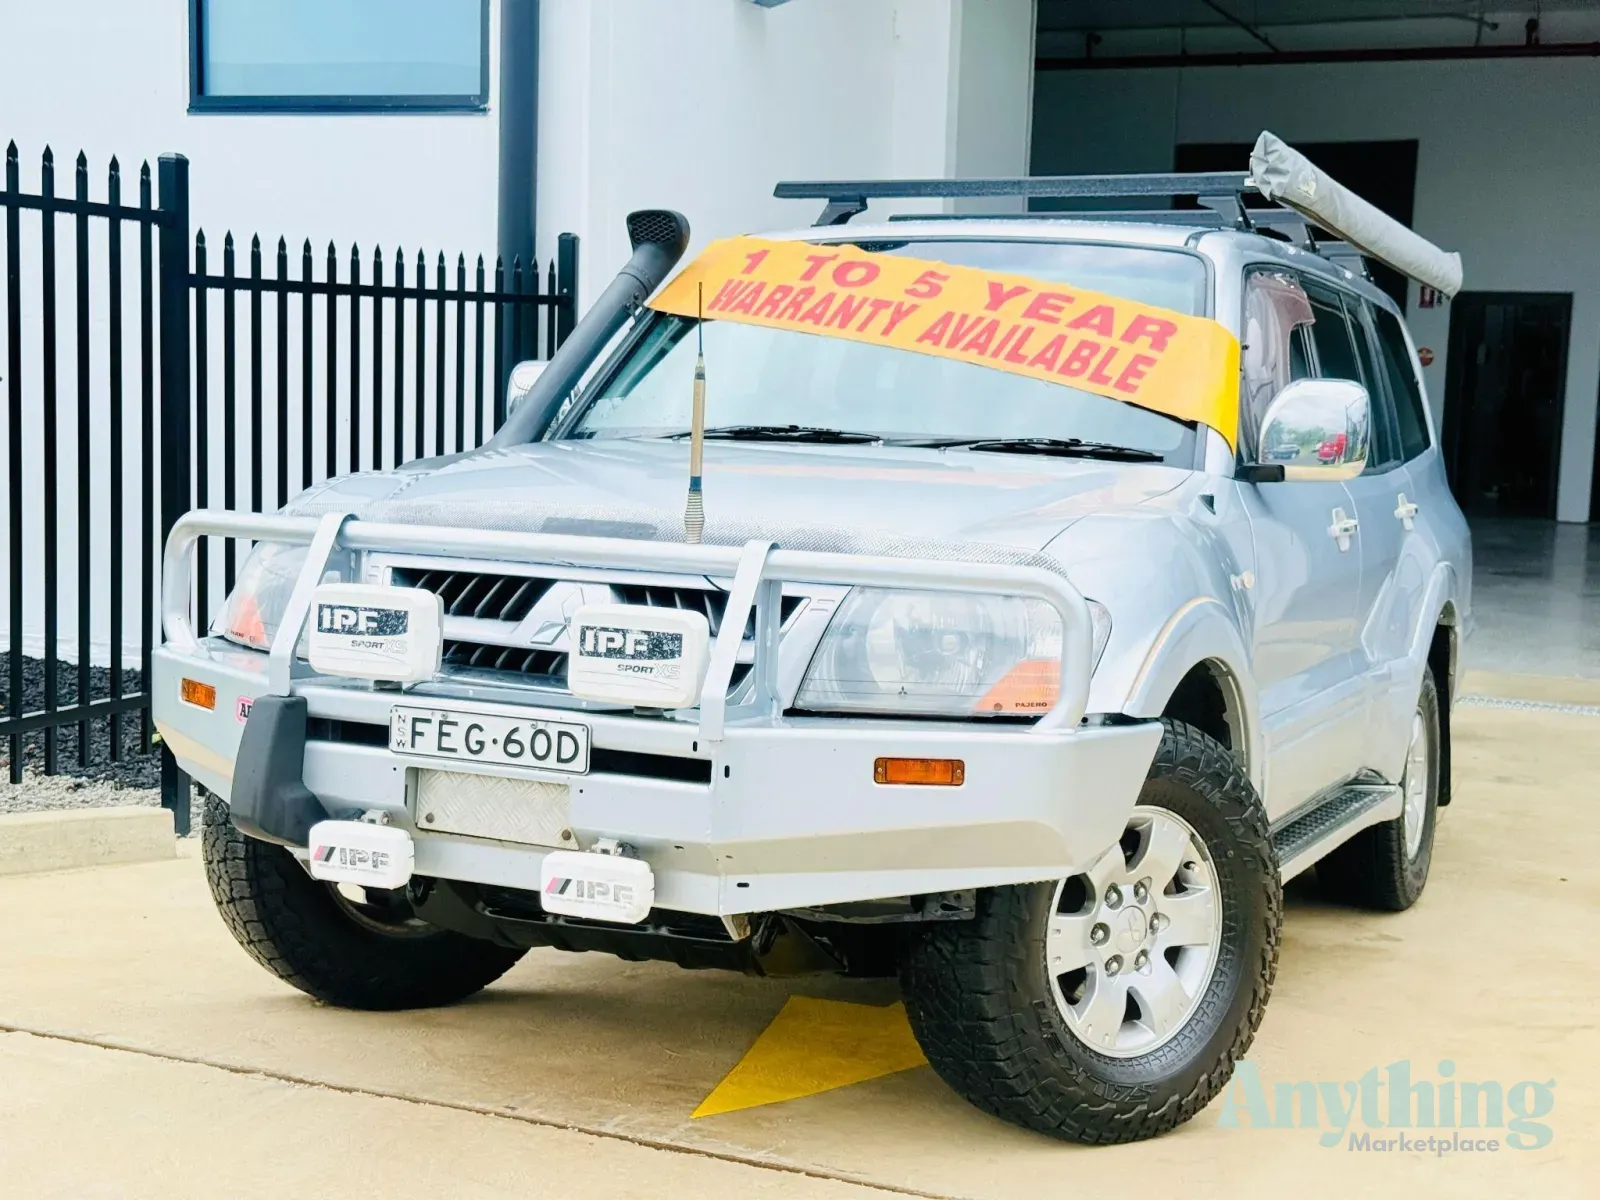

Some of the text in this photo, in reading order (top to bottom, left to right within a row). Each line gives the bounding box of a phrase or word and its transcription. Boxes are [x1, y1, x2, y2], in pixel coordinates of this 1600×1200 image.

[741, 249, 1178, 352] 1 TO 5 YEAR
[707, 279, 1157, 393] WARRANTY AVAILABLE
[322, 607, 378, 631] IPF
[584, 630, 648, 655] IPF
[617, 663, 654, 675] SPORT
[340, 847, 389, 869] IPF
[577, 879, 633, 904] IPF
